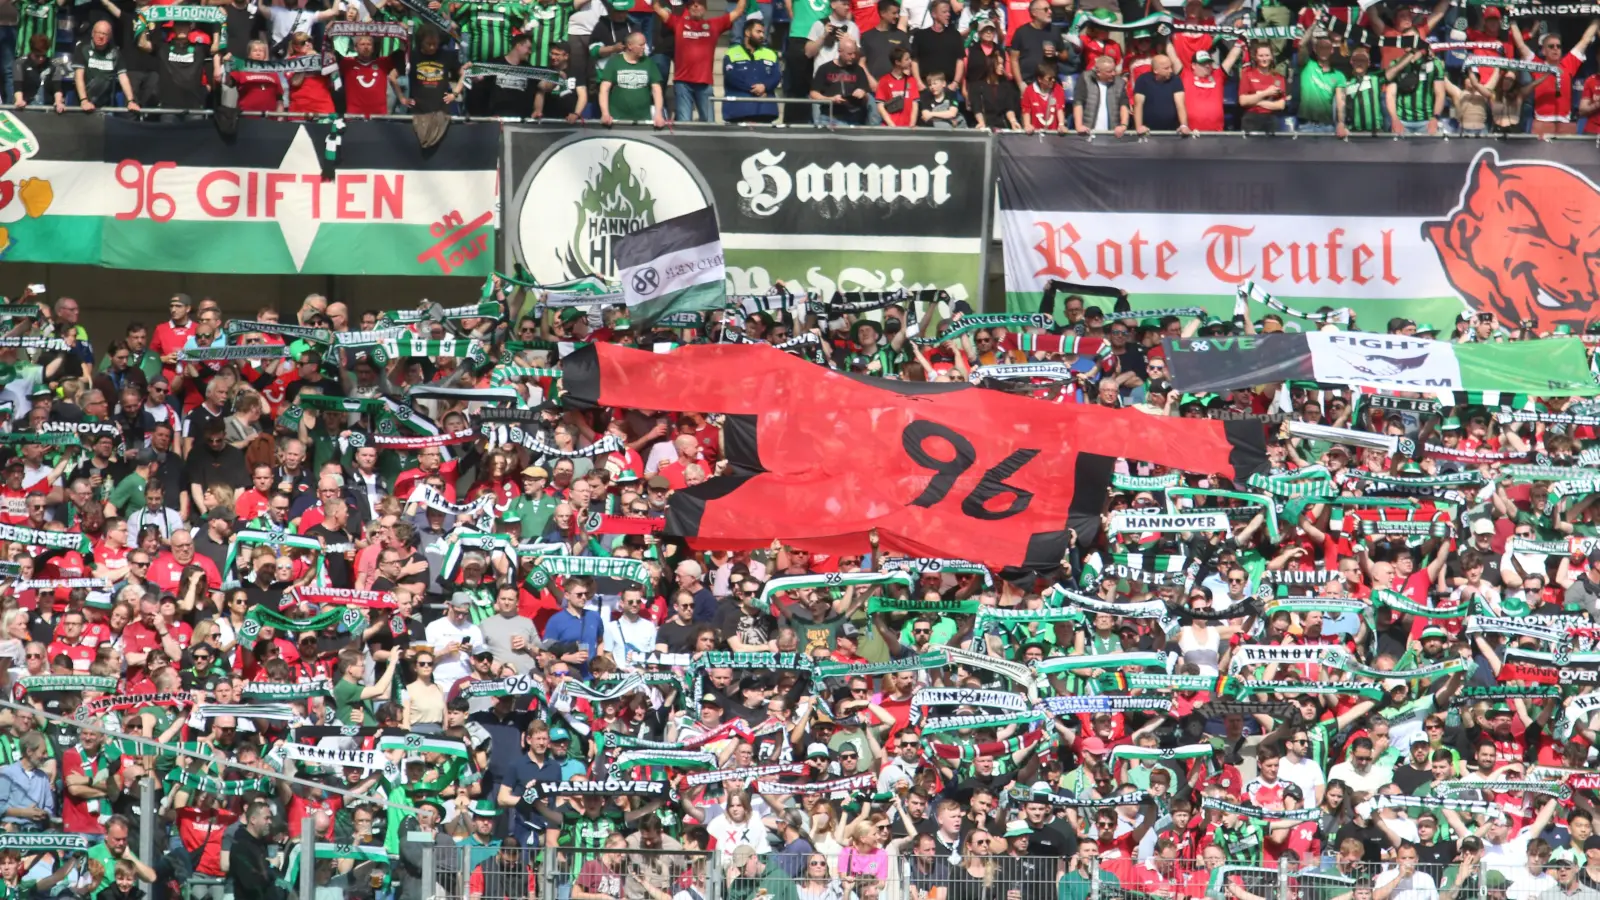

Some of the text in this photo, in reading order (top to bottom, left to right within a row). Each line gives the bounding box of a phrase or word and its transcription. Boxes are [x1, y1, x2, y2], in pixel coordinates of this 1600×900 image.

[115, 159, 404, 223] 96 GIFTEN
[429, 210, 464, 238] on
[434, 234, 490, 275] Tour
[1033, 221, 1401, 287] Rote Teufel
[902, 420, 1042, 520] 96
[1130, 516, 1221, 528] HANNOVER
[268, 532, 286, 543] 96
[918, 557, 942, 572] 96
[826, 573, 842, 583] 96
[300, 586, 378, 600] HANNOVER
[709, 652, 792, 665] BLOCK H
[1246, 648, 1322, 660] HANNOVE
[506, 676, 529, 693] 96
[1047, 699, 1104, 711] SCHALKE
[1113, 700, 1172, 713] HANNOVER
[405, 734, 422, 746] 96
[297, 746, 376, 765] HANNOVER
[541, 780, 664, 794] HANNOVER
